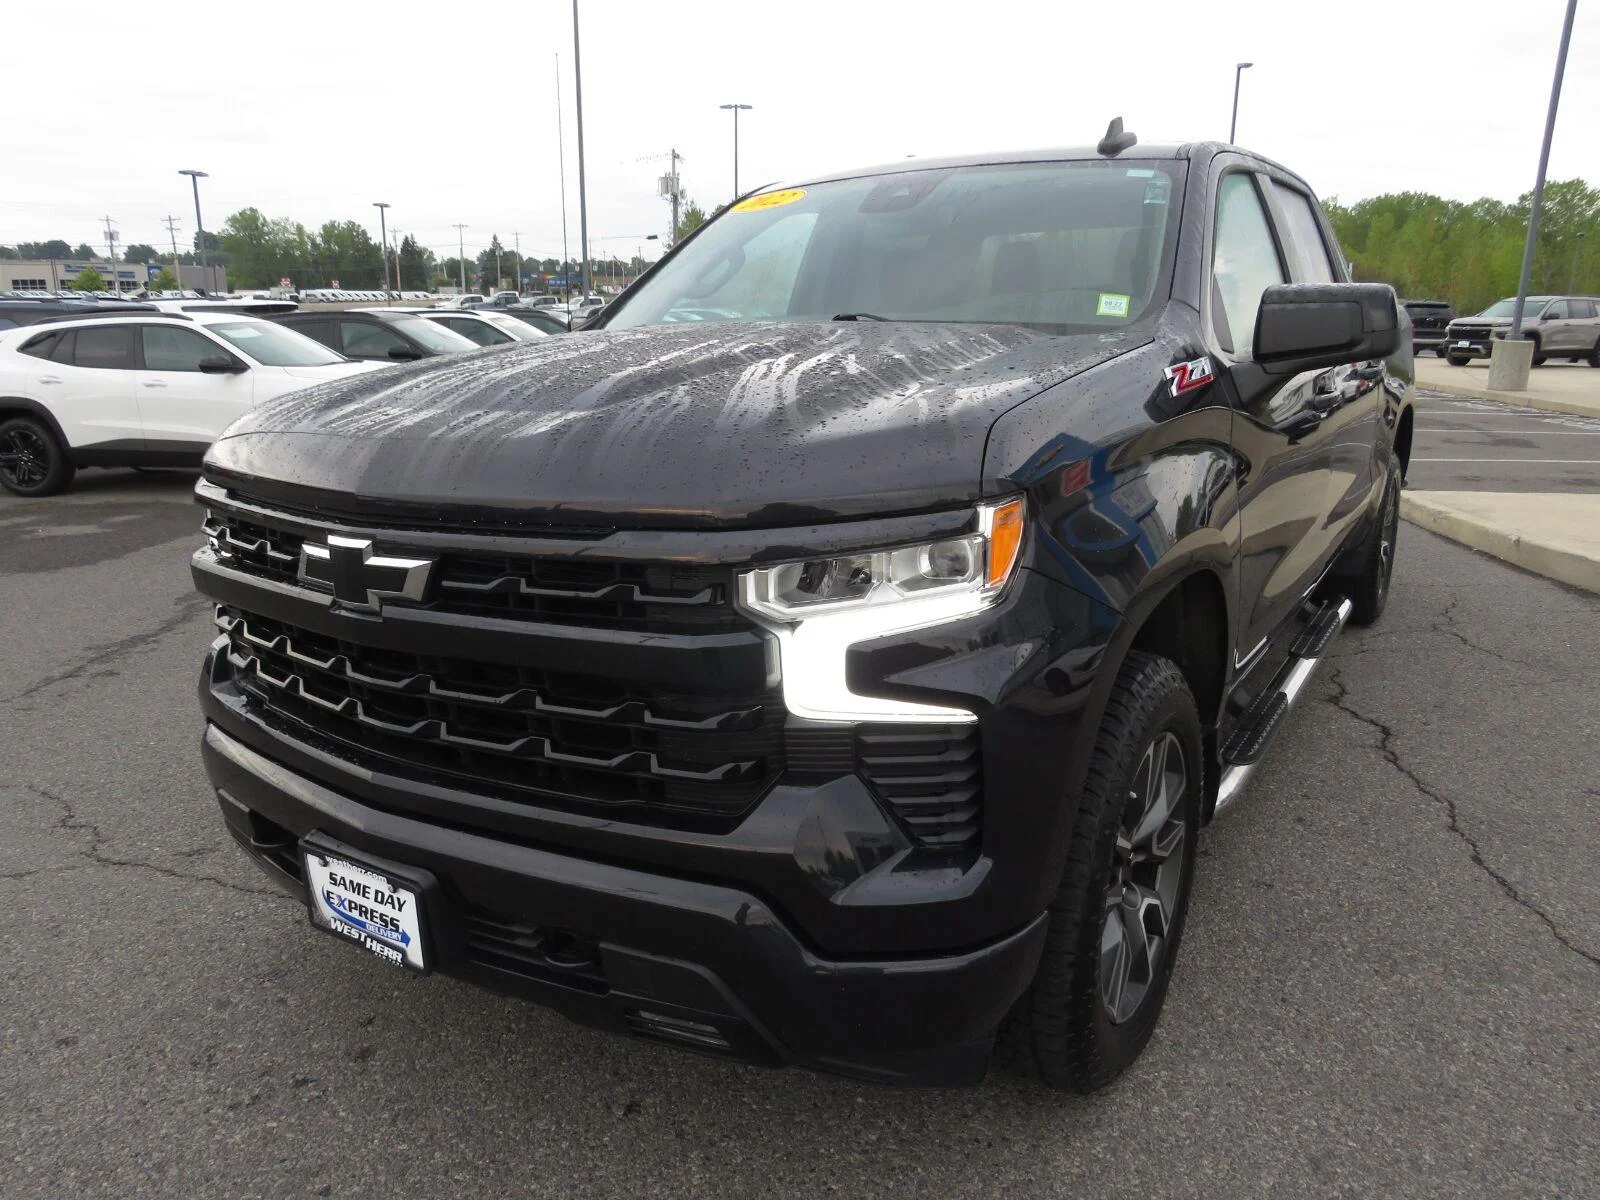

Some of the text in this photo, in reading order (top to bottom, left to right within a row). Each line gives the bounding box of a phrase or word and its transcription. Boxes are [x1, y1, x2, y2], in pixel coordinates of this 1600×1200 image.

[1163, 356, 1214, 397] Z71
[326, 889, 400, 931] EXPRESS
[329, 871, 406, 912] SAME DAY
[365, 921, 402, 942] DELIVERY
